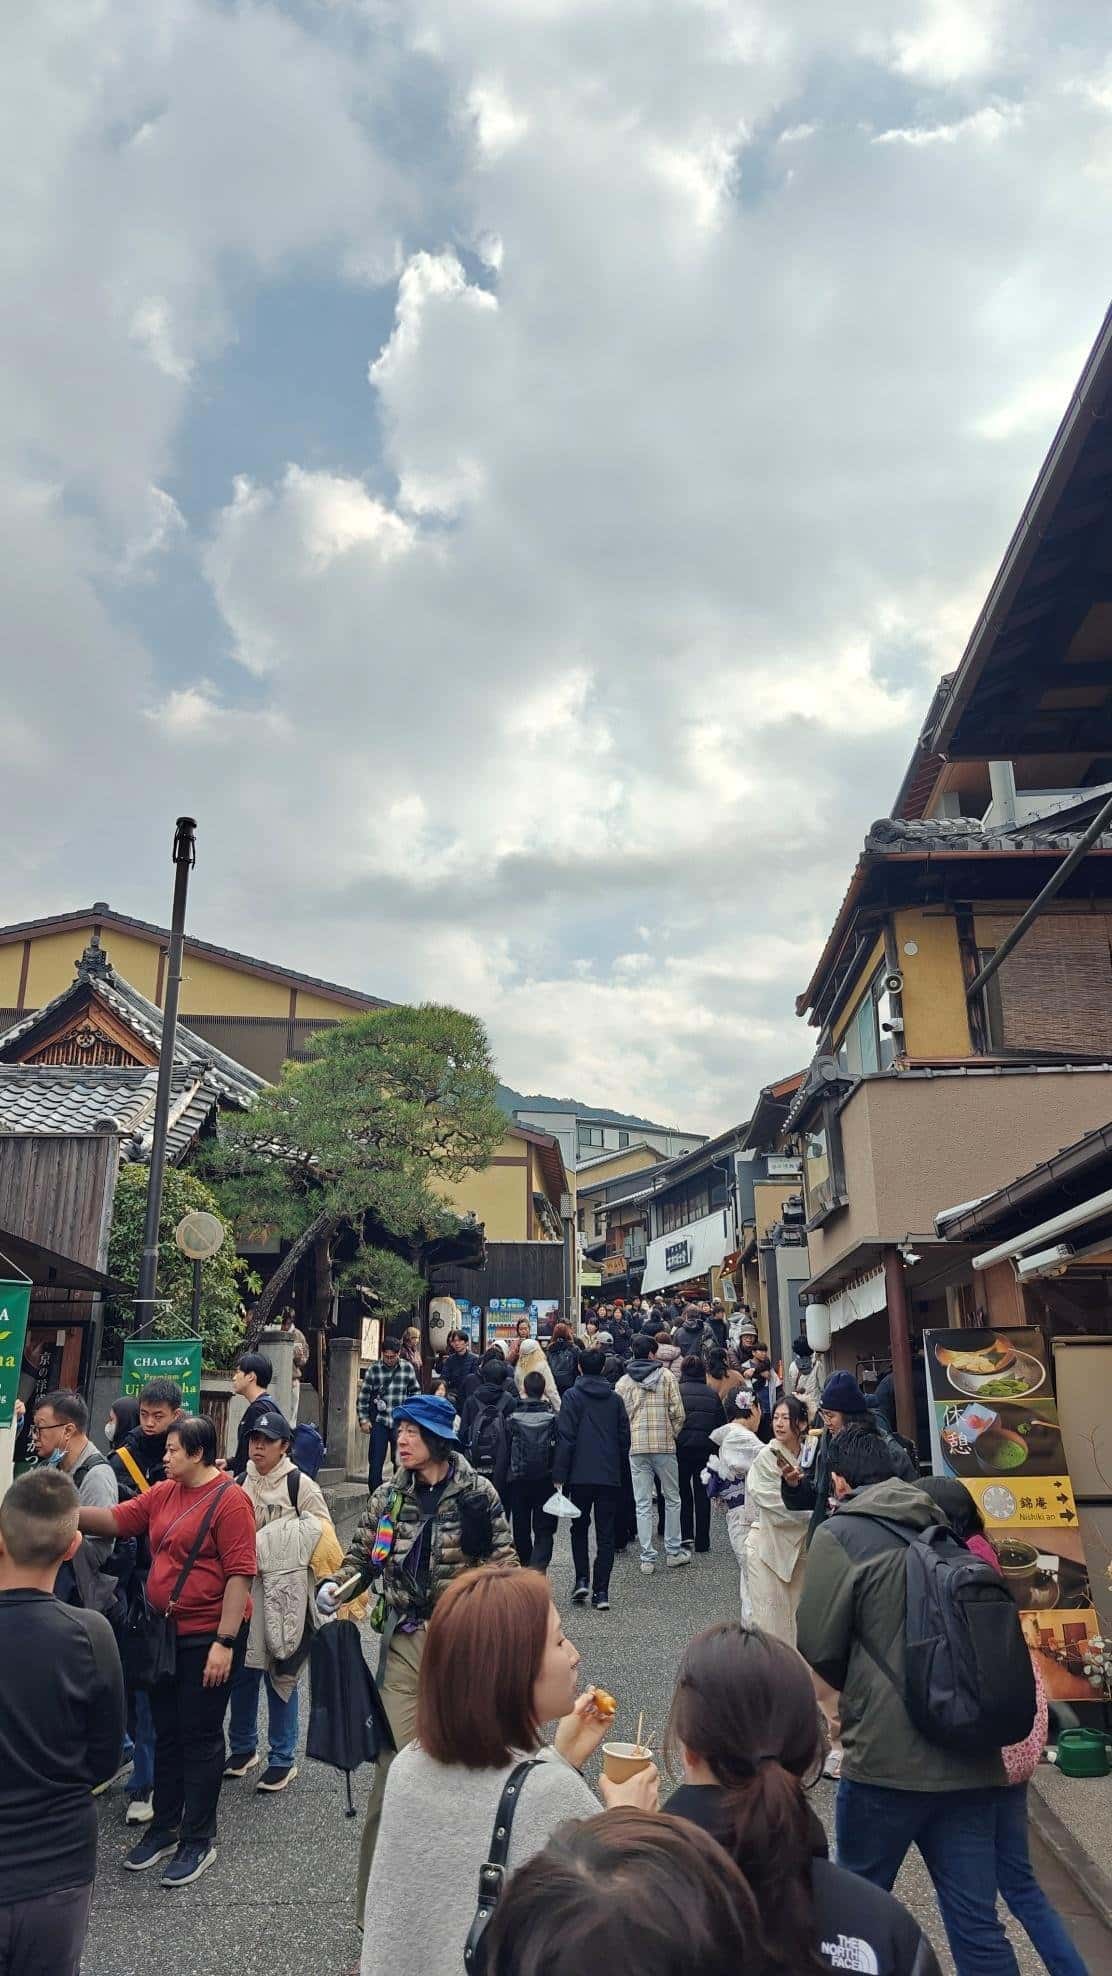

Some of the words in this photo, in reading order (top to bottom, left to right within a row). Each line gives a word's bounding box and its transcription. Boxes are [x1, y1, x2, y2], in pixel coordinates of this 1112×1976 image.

[133, 1357, 158, 1367] CHA
[175, 1356, 190, 1366] KA
[943, 1404, 972, 1455] 休憩
[837, 1934, 859, 1950] THE
[821, 1941, 858, 1961] NORTH
[831, 1955, 860, 1970] FACE
